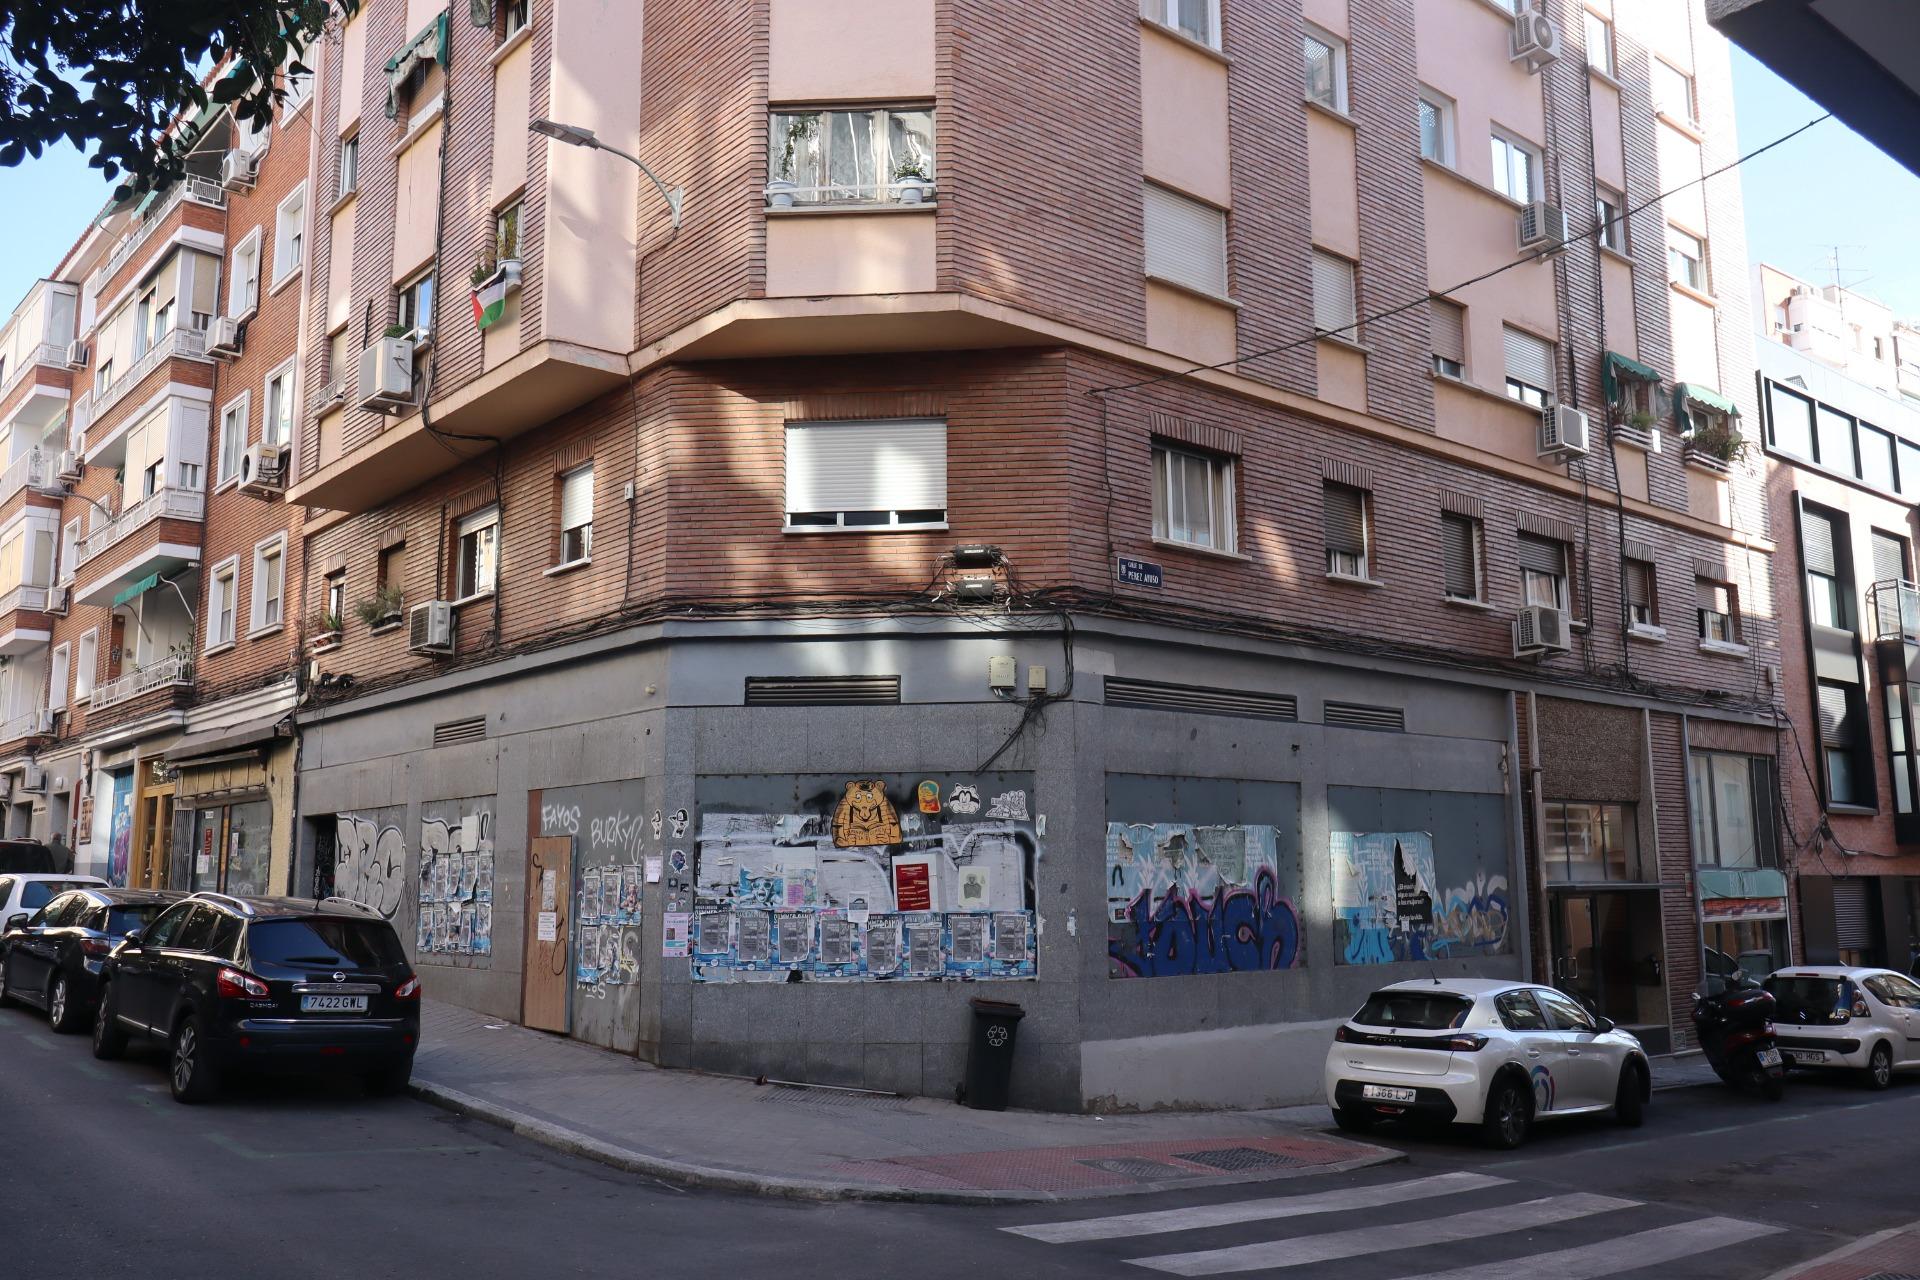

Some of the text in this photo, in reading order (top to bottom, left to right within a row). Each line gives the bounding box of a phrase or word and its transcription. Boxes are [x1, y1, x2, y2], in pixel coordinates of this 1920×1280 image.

[1144, 573, 1159, 585] AYUSO
[310, 997, 363, 1009] 7422 GWL
[1370, 1087, 1414, 1101] 1366 LJP
